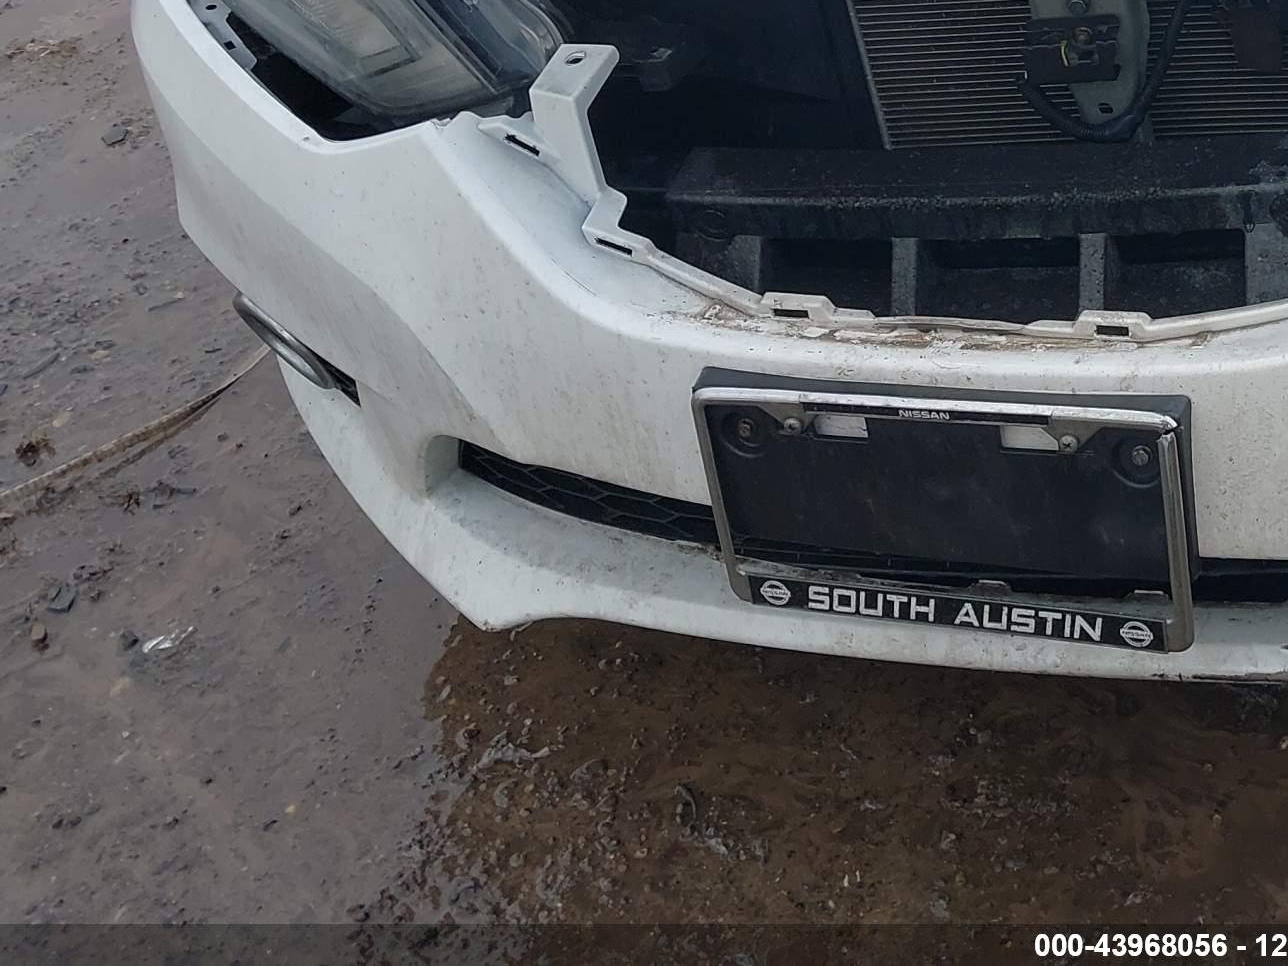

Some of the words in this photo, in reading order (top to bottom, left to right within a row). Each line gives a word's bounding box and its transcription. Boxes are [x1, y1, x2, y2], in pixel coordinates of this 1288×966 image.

[898, 409, 950, 420] NISSAN
[808, 586, 935, 623] SOUTH
[953, 602, 1102, 641] AUSTIN
